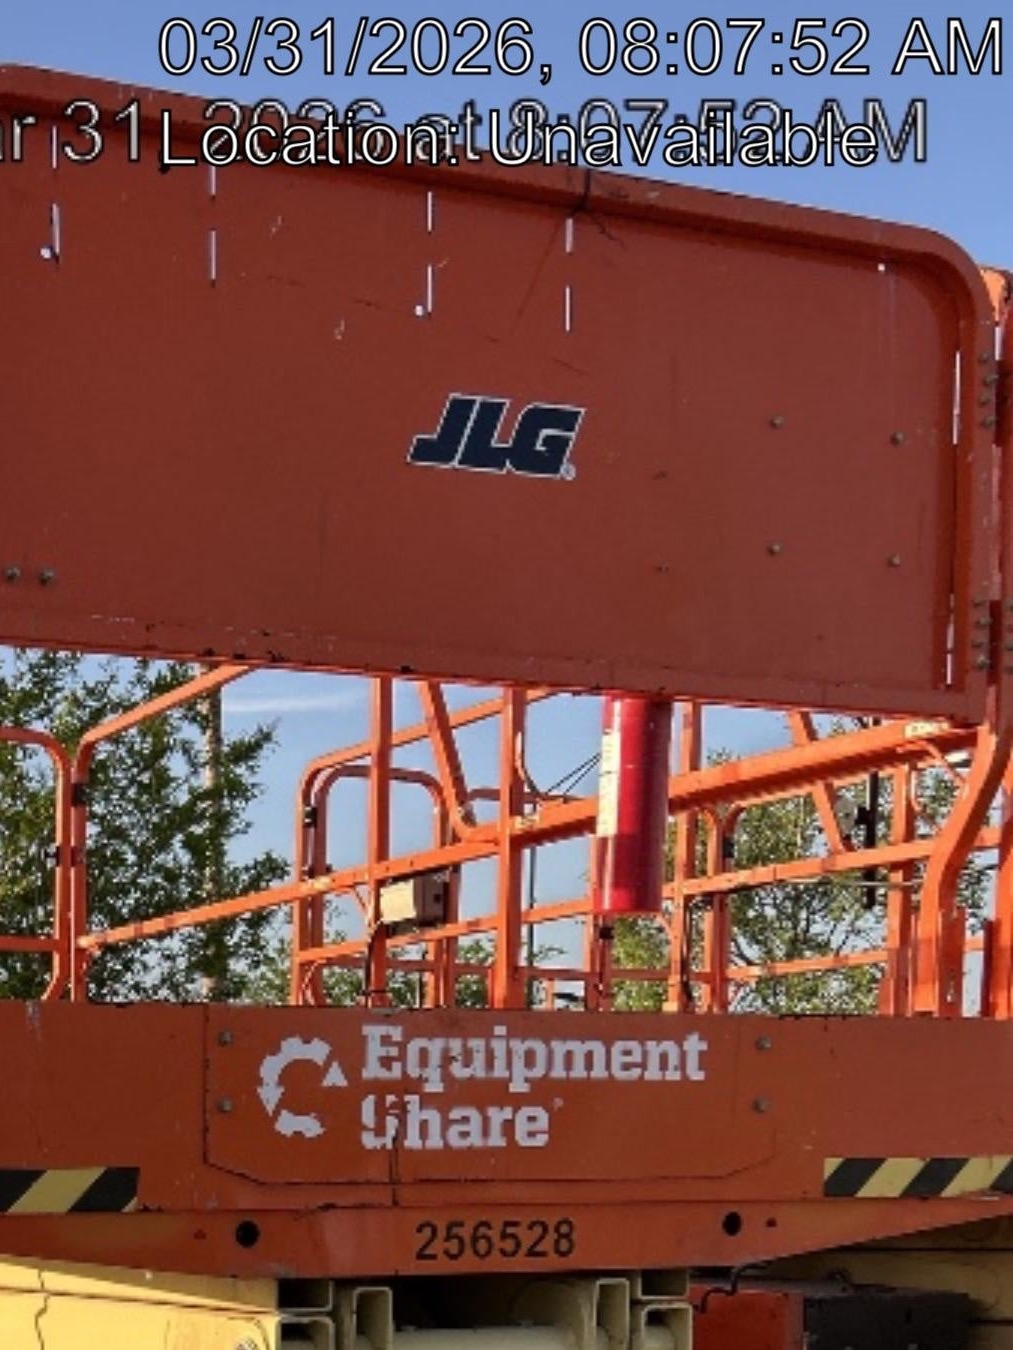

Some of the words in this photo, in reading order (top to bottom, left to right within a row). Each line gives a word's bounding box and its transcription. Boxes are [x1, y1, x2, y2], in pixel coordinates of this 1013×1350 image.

[404, 392, 586, 481] JLG
[361, 1024, 710, 1093] Equipment
[361, 1094, 551, 1151] Share
[414, 1217, 577, 1261] 256528
